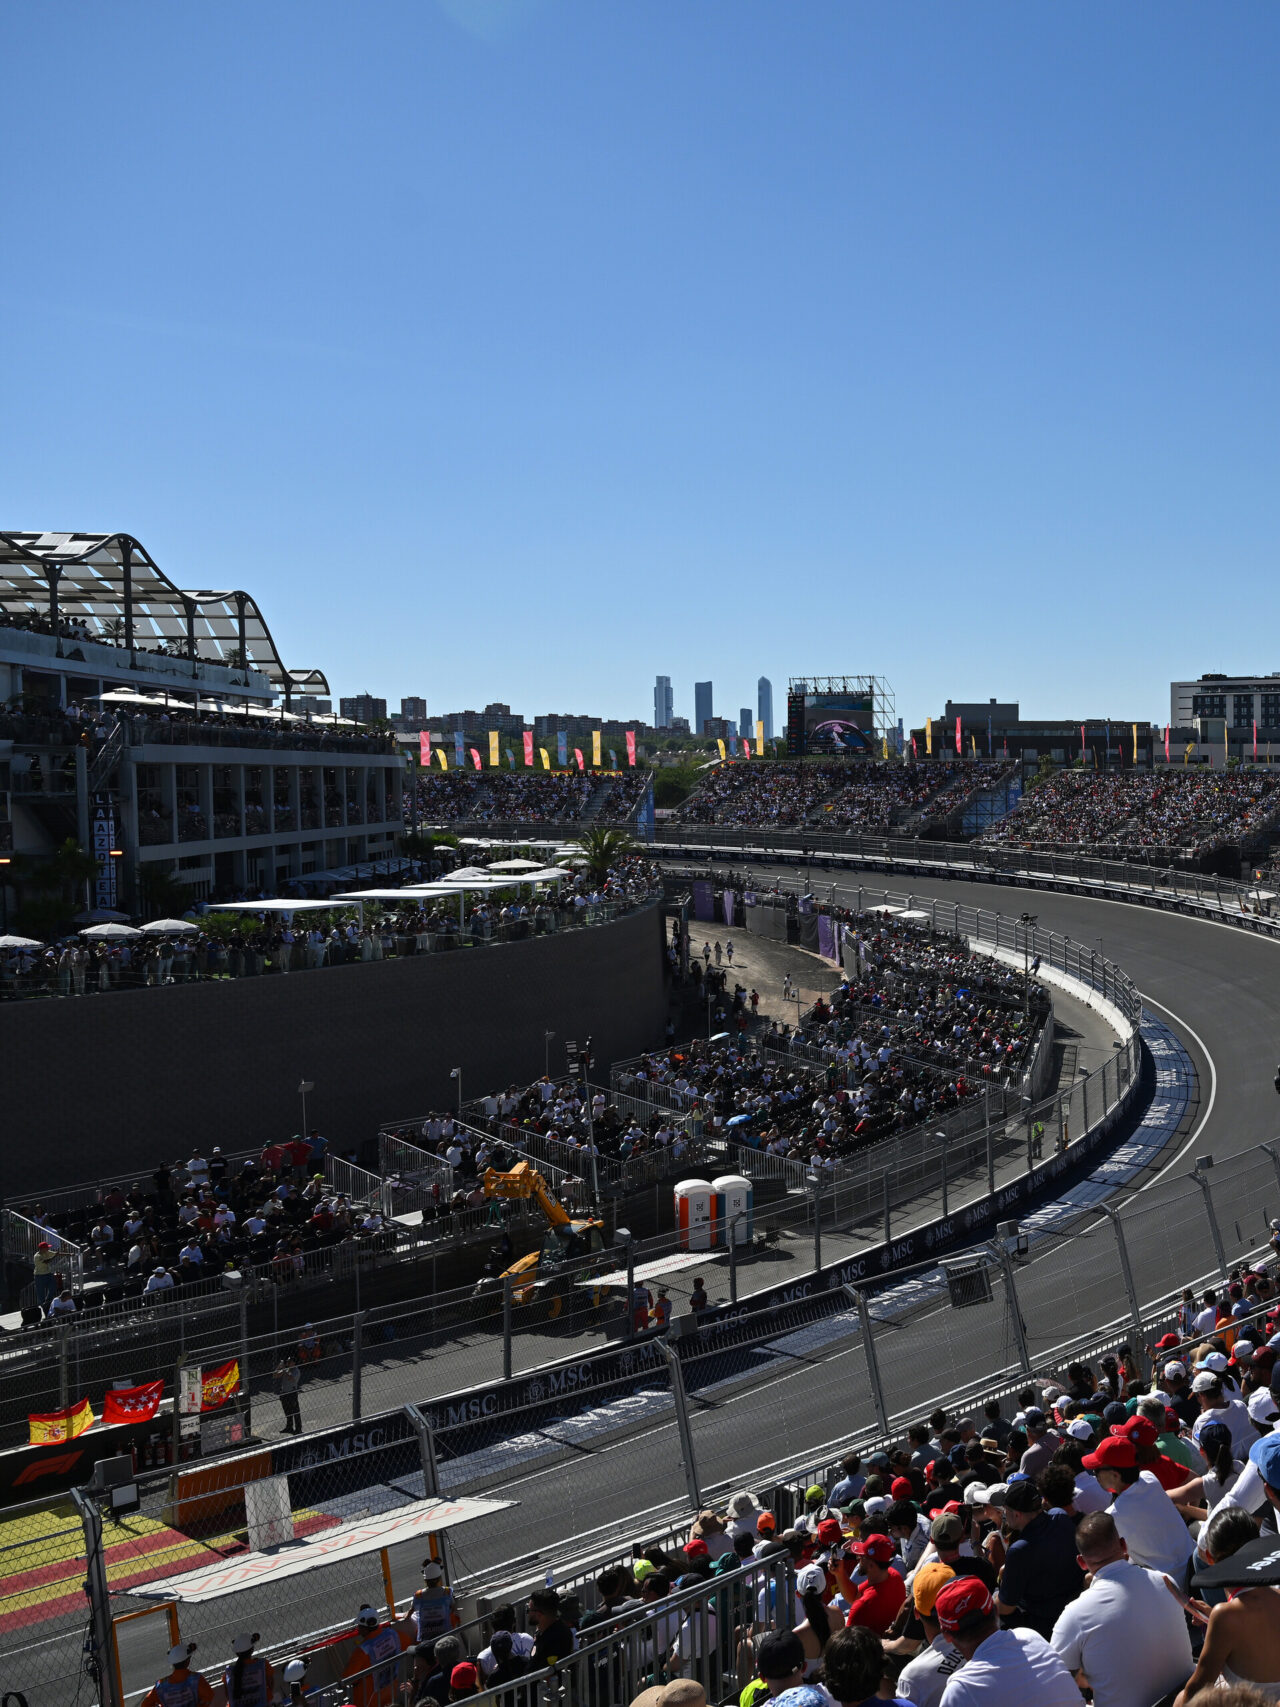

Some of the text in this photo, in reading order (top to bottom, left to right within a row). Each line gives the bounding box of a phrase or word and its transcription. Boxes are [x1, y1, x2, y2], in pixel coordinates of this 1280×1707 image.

[1034, 1170, 1046, 1186] MSC
[1005, 1186, 1019, 1202] MSC
[973, 1202, 990, 1222] MSC
[935, 1220, 955, 1242] MSC
[892, 1239, 913, 1262] MSC
[841, 1260, 866, 1283] MSC
[783, 1282, 813, 1302] MSC
[716, 1306, 748, 1335] MSC
[549, 1362, 593, 1392] MSC
[448, 1393, 497, 1427] MSC
[327, 1427, 384, 1459] MSC
